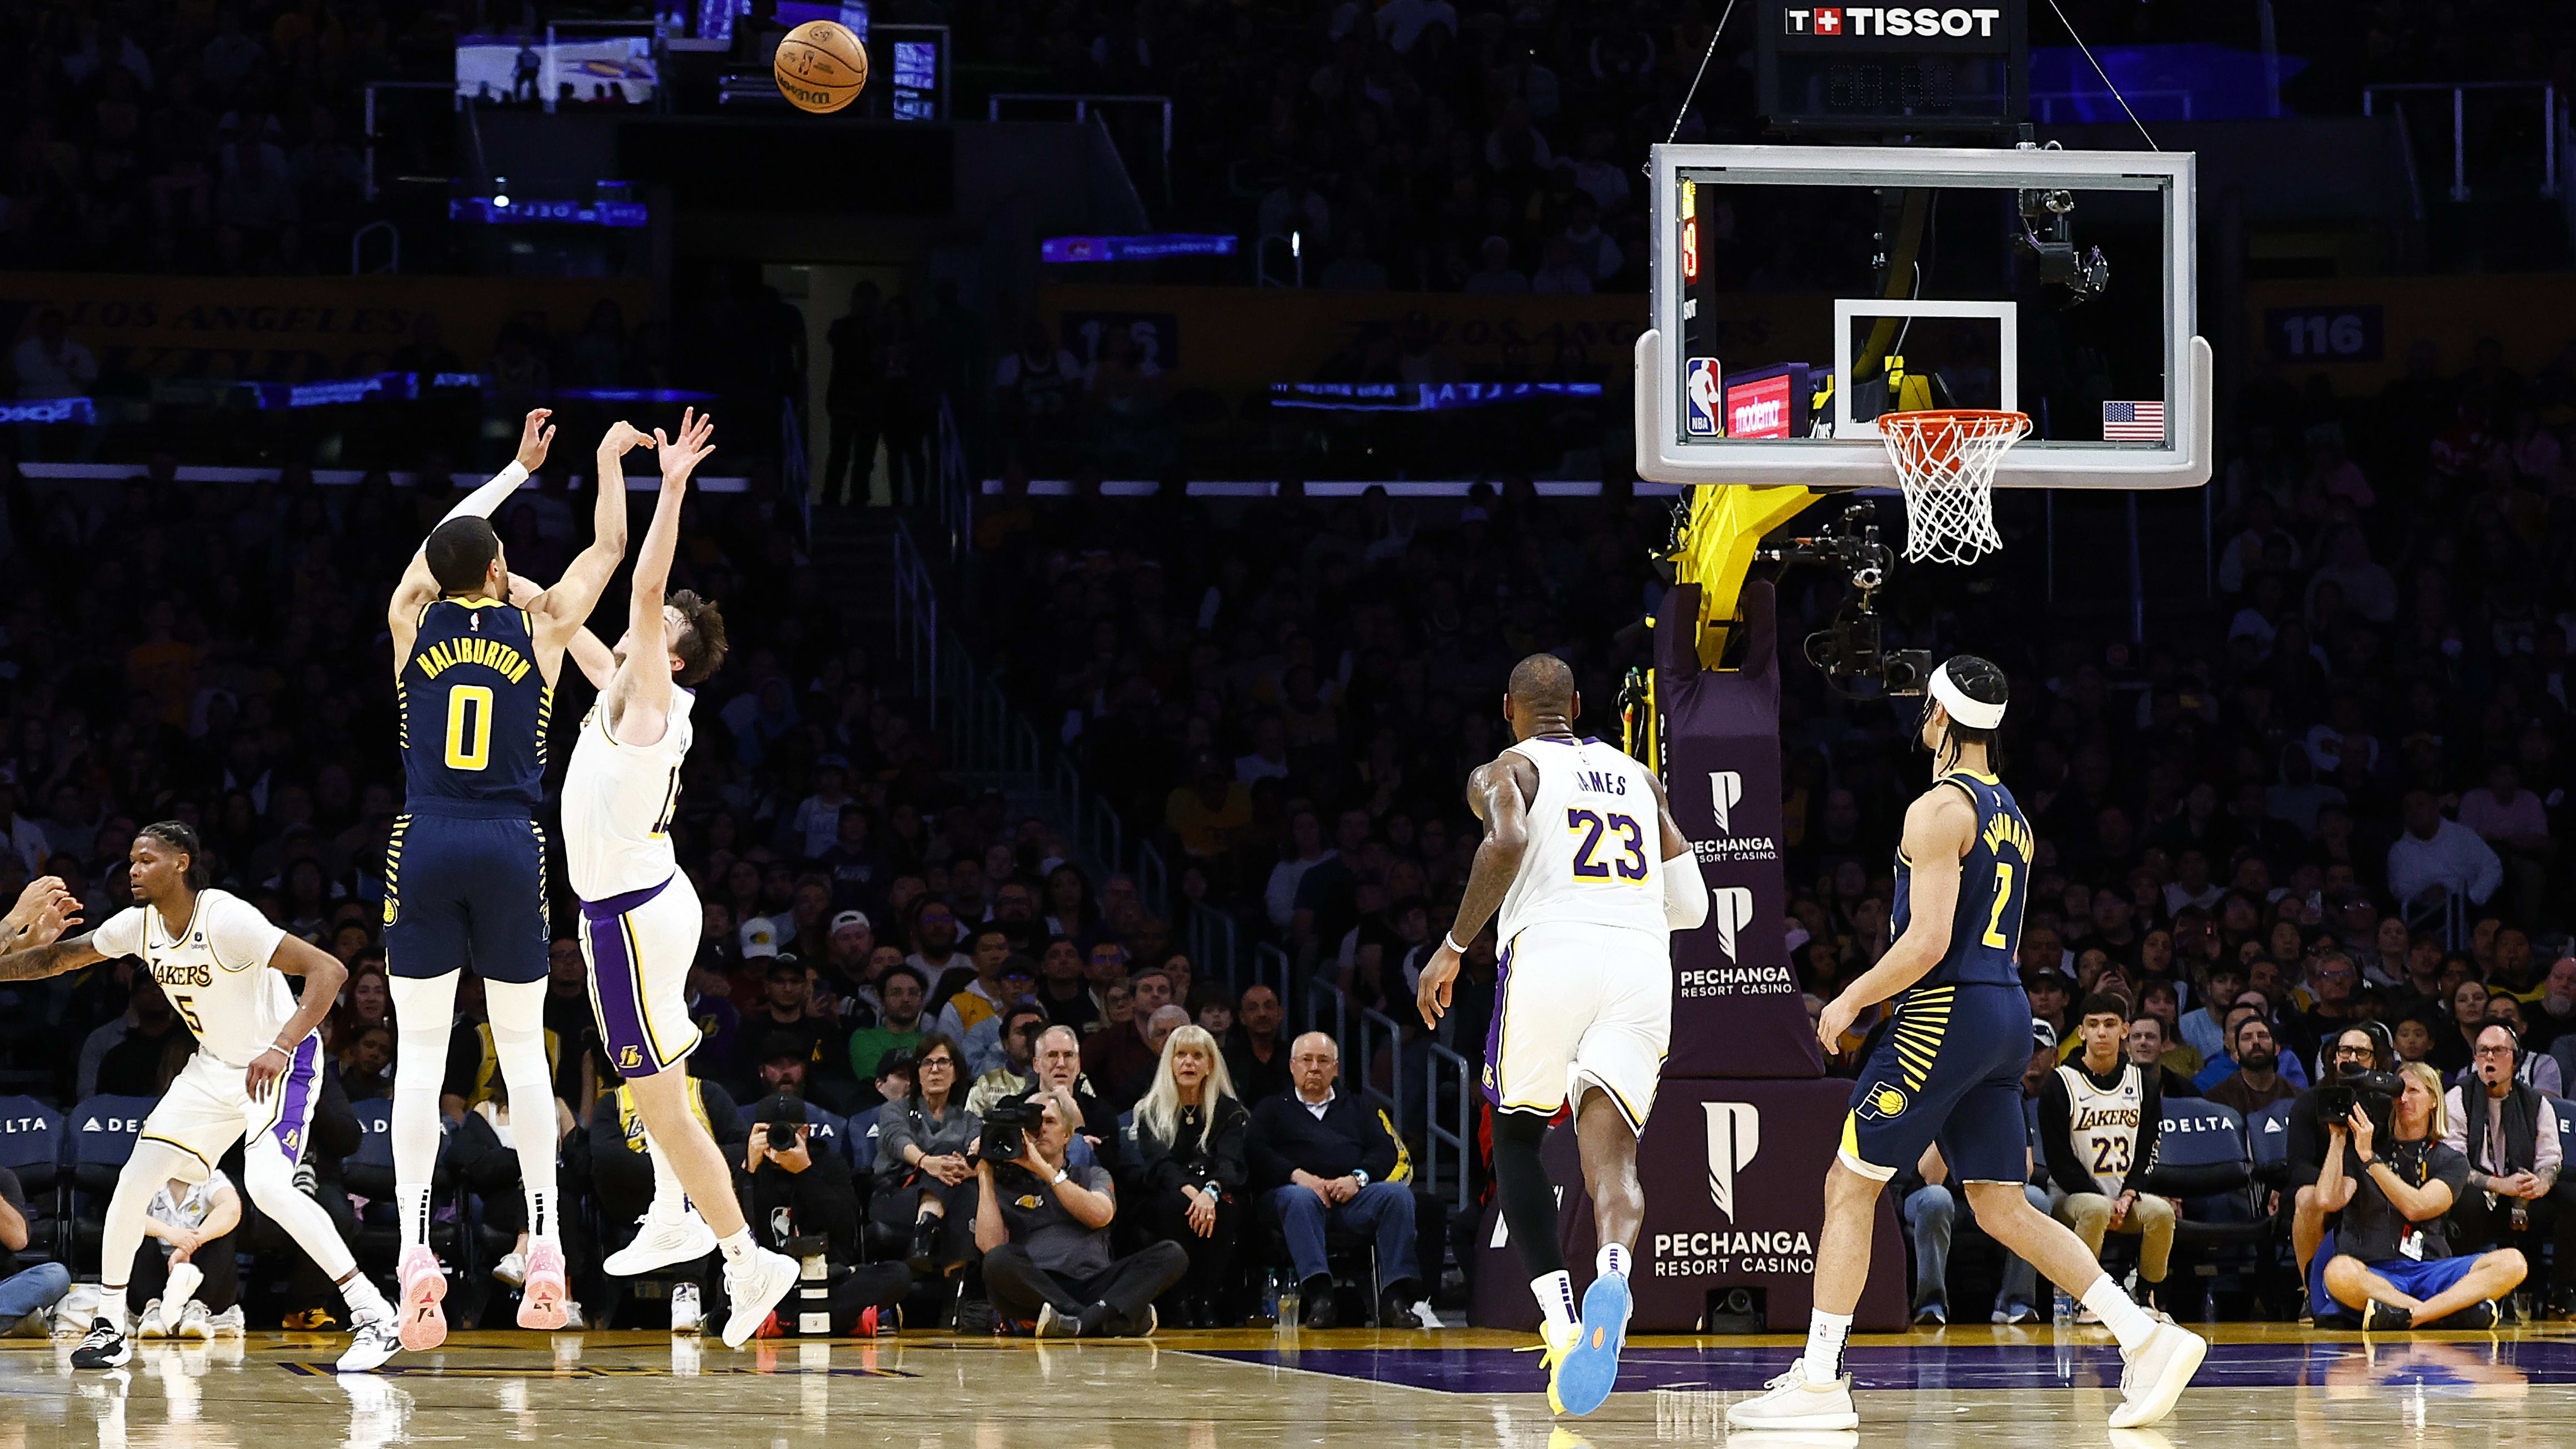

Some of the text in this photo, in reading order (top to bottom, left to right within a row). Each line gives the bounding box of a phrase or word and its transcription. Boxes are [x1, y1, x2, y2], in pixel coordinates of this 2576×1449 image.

[1846, 7, 1999, 37] TISSOT
[2284, 314, 2364, 354] 116
[1692, 417, 1708, 430] NBA
[416, 638, 531, 684] HALIBURTON
[445, 684, 493, 771] 0
[1567, 807, 1650, 886] 23
[1697, 853, 1728, 864] SORT
[1982, 862, 2013, 950] 2
[152, 958, 213, 988] LAKERS
[1680, 966, 1792, 987] PECHANGA
[1681, 985, 1734, 998] RESORT
[173, 995, 204, 1036] 5
[0, 1116, 48, 1134] LTA
[2073, 1107, 2139, 1132] LAKERS
[2163, 1116, 2235, 1133] DELTA
[2092, 1136, 2131, 1177] 23
[1654, 1230, 1813, 1258] PECHANGA
[1654, 1257, 1814, 1277] RESORT CASINO
